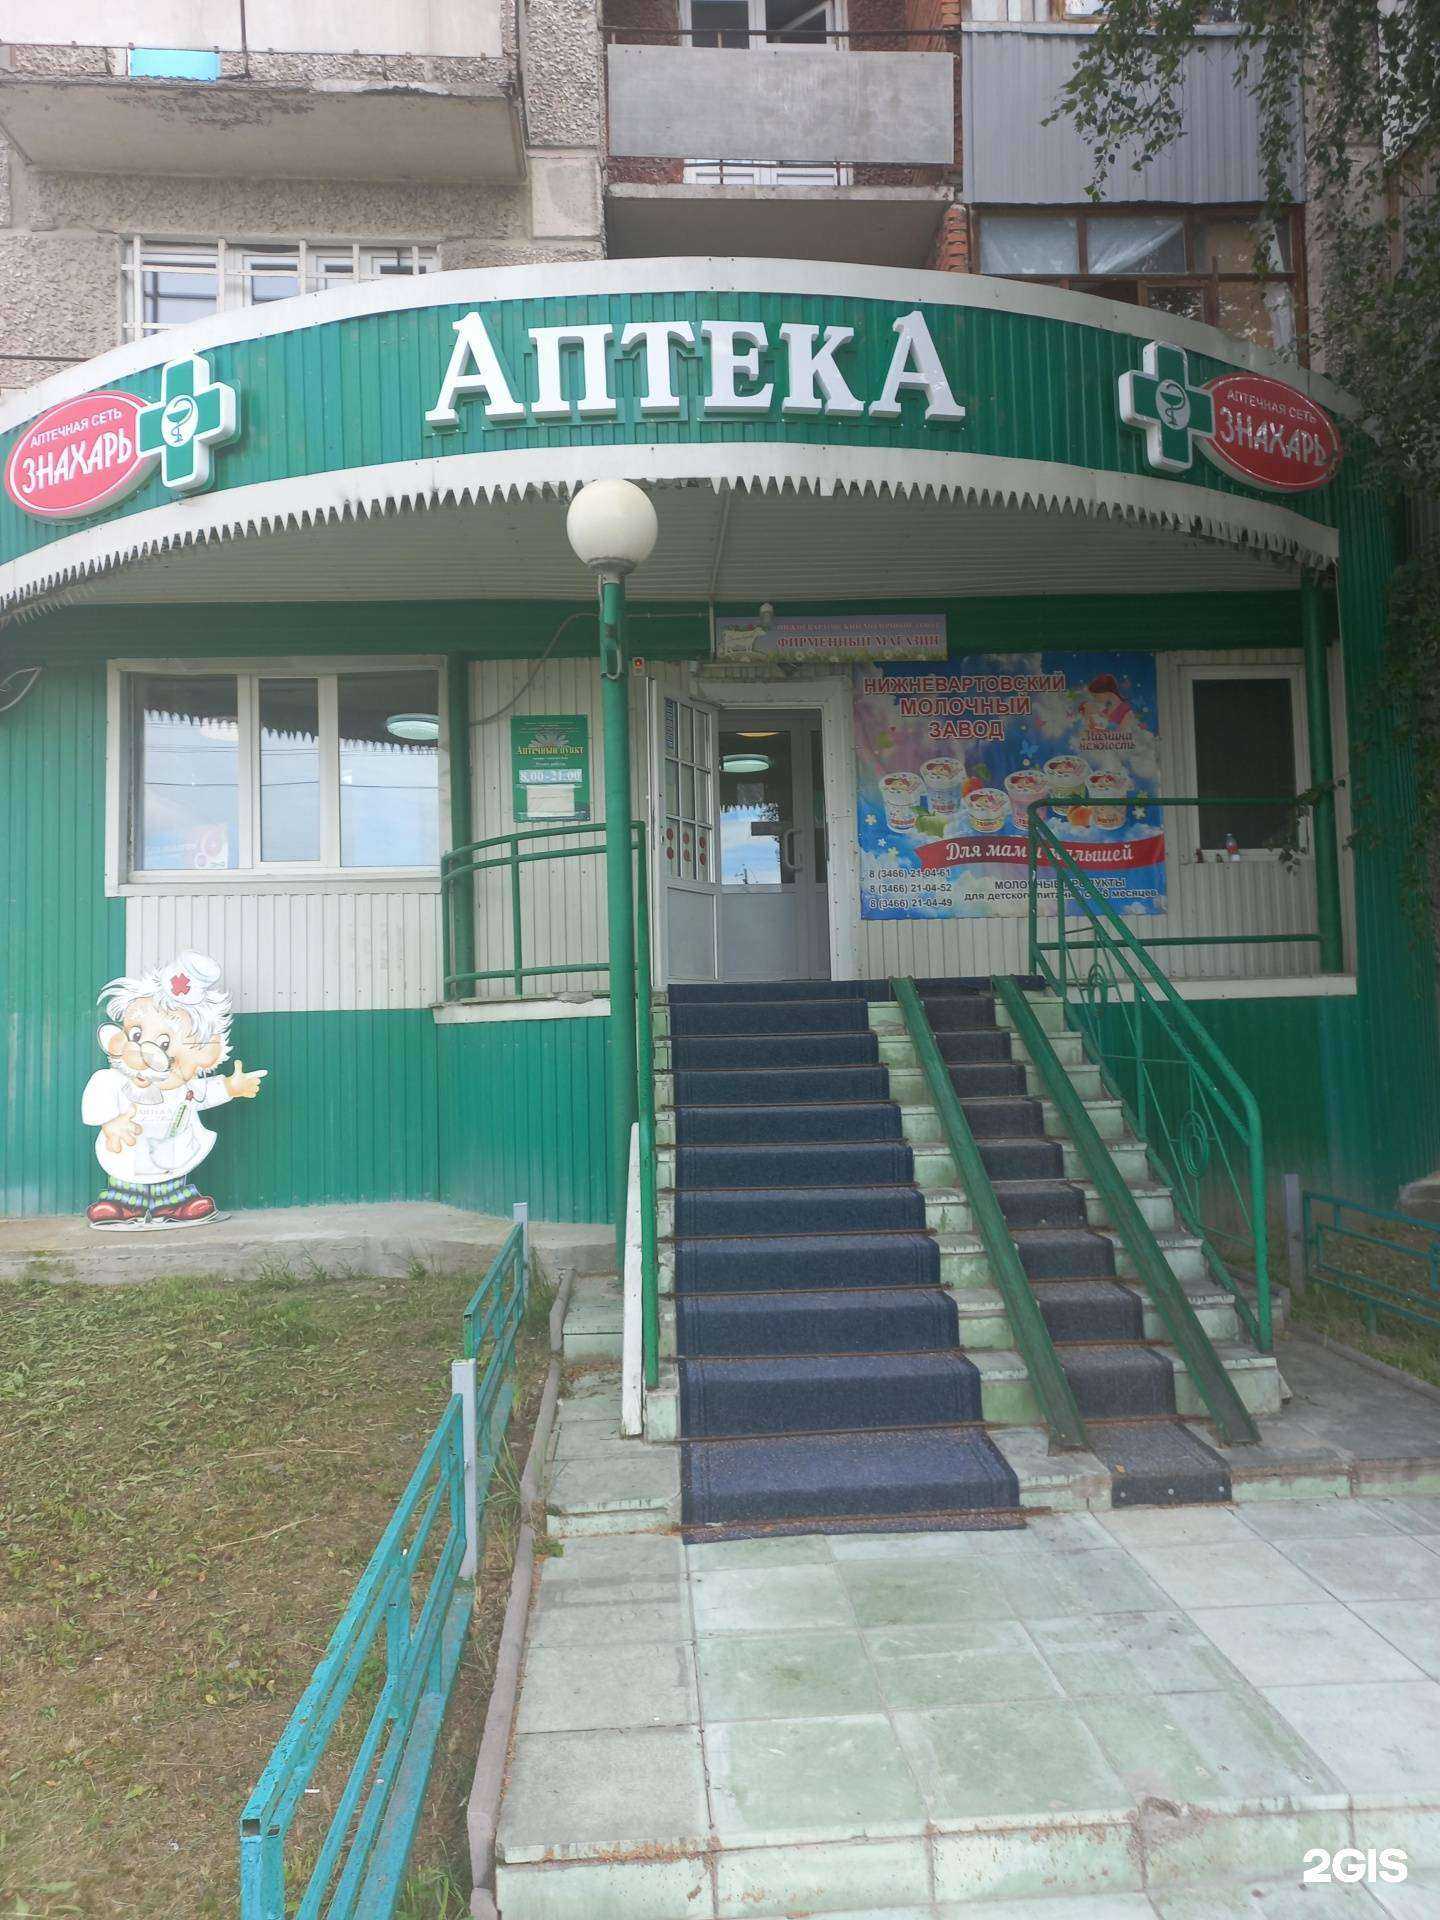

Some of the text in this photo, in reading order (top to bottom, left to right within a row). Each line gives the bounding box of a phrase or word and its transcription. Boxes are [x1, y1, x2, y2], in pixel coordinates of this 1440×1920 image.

[424, 310, 967, 427] АПТЕКА
[1226, 389, 1317, 424] АПТЕЧНАЯ СЕТЬ
[30, 407, 123, 448] АПТЕЧНАЯ СЕТЬ
[1218, 406, 1328, 467] ЗНАХАРЬ
[21, 427, 134, 494] ЗНАХАРЬ
[863, 670, 1067, 694] НИЖНЕВАРТОВСКИЙ
[899, 691, 1032, 716] МОЛОЧНЫЙ
[928, 720, 1006, 742] ЗАВОД
[945, 842, 982, 861] Для
[985, 844, 1028, 859] мам
[869, 869, 875, 878] 8
[877, 869, 907, 880] (3466)
[869, 884, 876, 893] 8
[878, 884, 908, 894] (3466)
[964, 892, 984, 901] для
[987, 891, 1034, 902] детског
[869, 899, 876, 908] 8
[879, 899, 908, 910] (3466)
